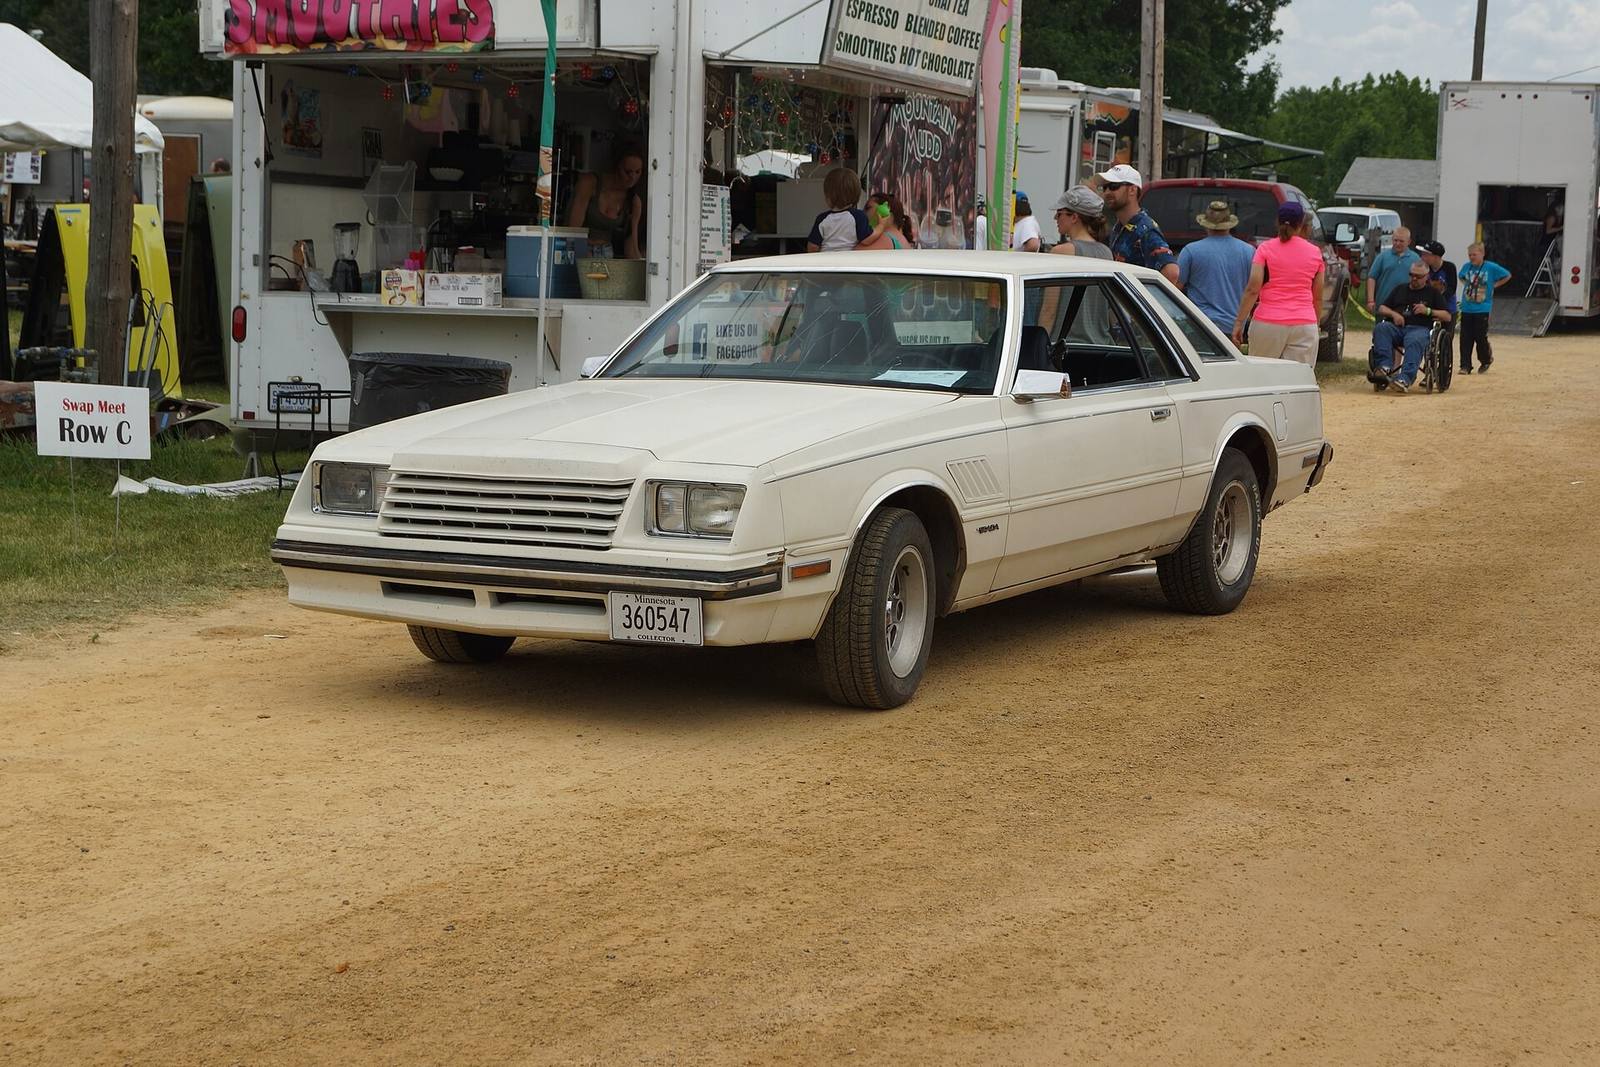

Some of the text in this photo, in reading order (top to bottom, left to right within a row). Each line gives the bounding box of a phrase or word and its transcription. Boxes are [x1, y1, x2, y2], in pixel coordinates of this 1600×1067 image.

[226, 0, 493, 46] SMOOTHIES
[846, 0, 981, 50] ESPRESSO BLENDED COFFEE
[836, 32, 975, 80] SMOOTHIES HOT CHOCOLATE
[888, 96, 957, 143] MOUNTAIN
[903, 122, 942, 170] MUDD
[716, 324, 758, 337] LIKE US ON
[717, 345, 758, 360] FACEBOOK
[62, 398, 126, 415] Swap Meet
[59, 417, 132, 445] Row C
[634, 594, 676, 606] Minnesota
[622, 604, 690, 633] 360547
[637, 634, 676, 642] COLLECTOR
